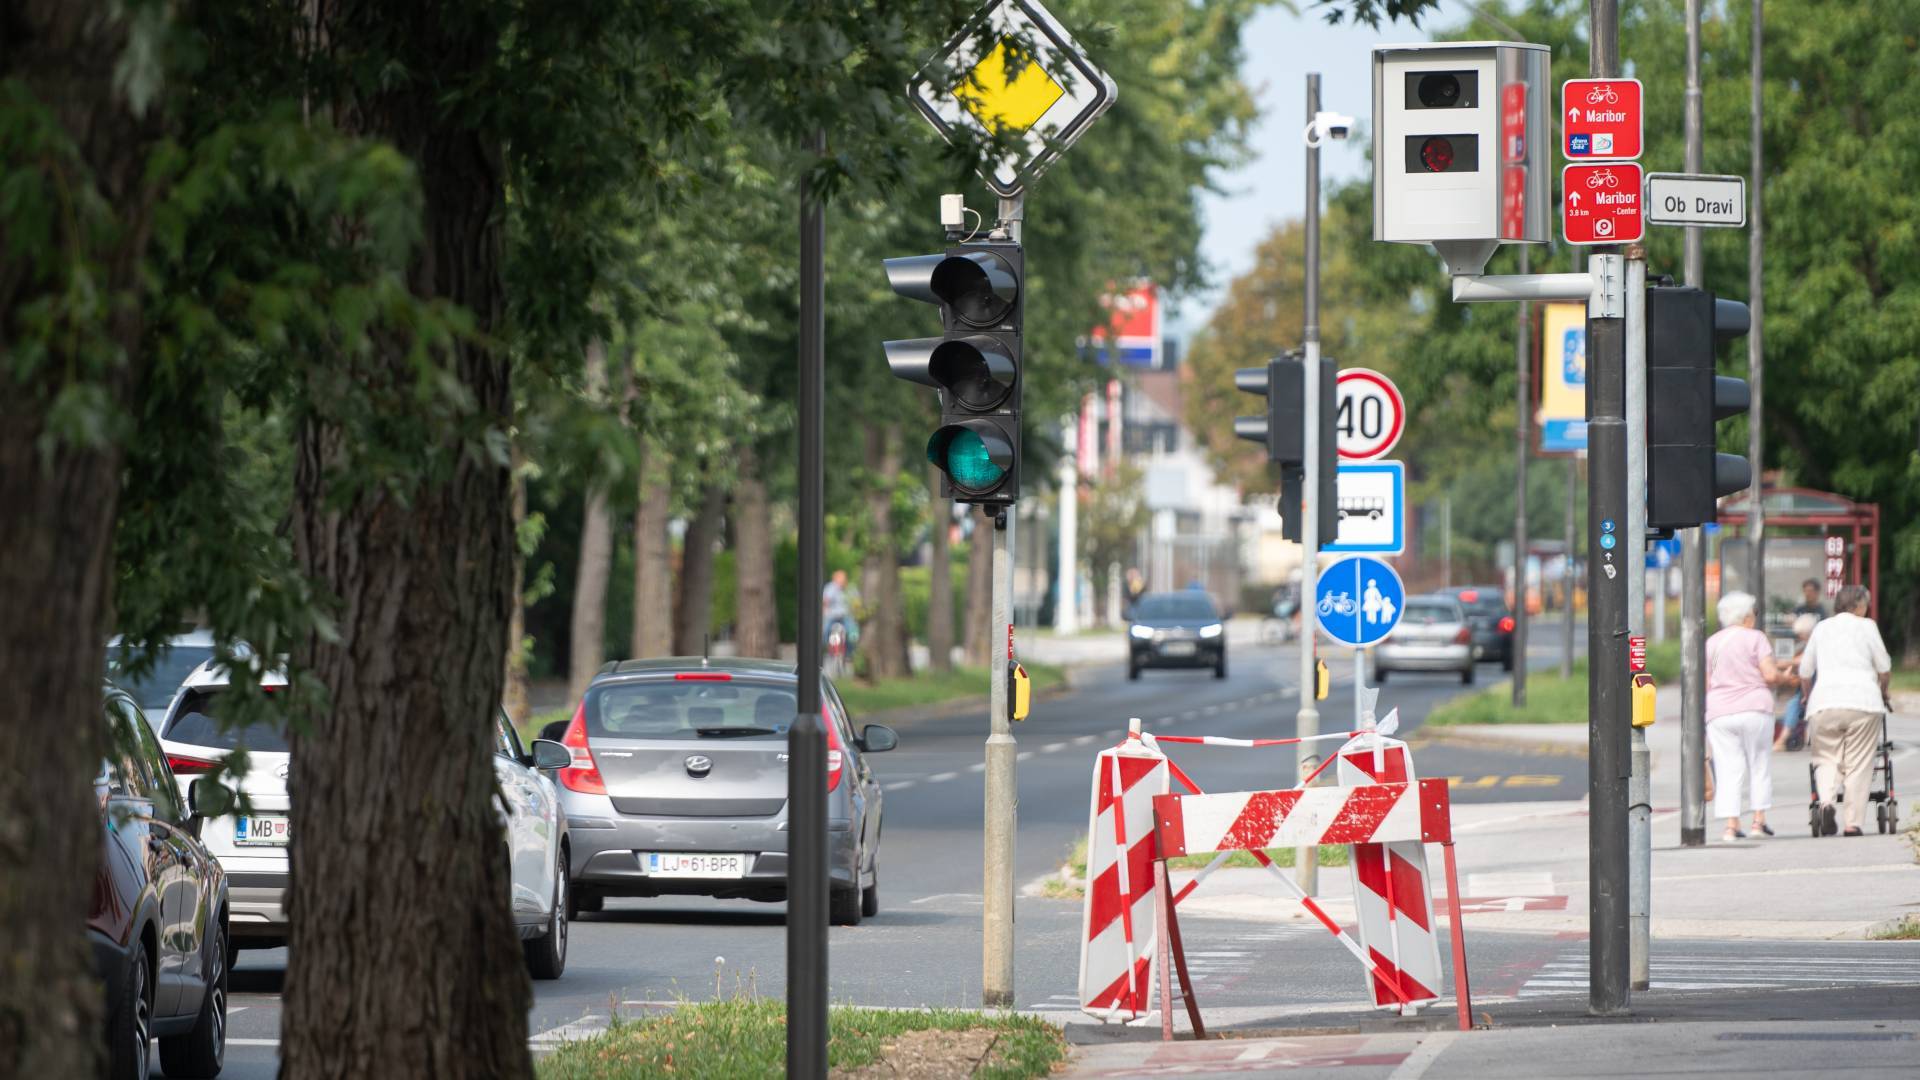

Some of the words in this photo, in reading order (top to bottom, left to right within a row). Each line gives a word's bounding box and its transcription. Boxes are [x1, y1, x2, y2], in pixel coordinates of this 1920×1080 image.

[1586, 110, 1626, 122] Maribor
[1596, 192, 1636, 205] Maribor
[1664, 196, 1686, 213] Ob
[1695, 197, 1733, 214] Dravi
[1336, 395, 1382, 439] 40
[251, 820, 272, 837] MB
[663, 857, 680, 871] LJ
[691, 857, 738, 872] 61-BPR
